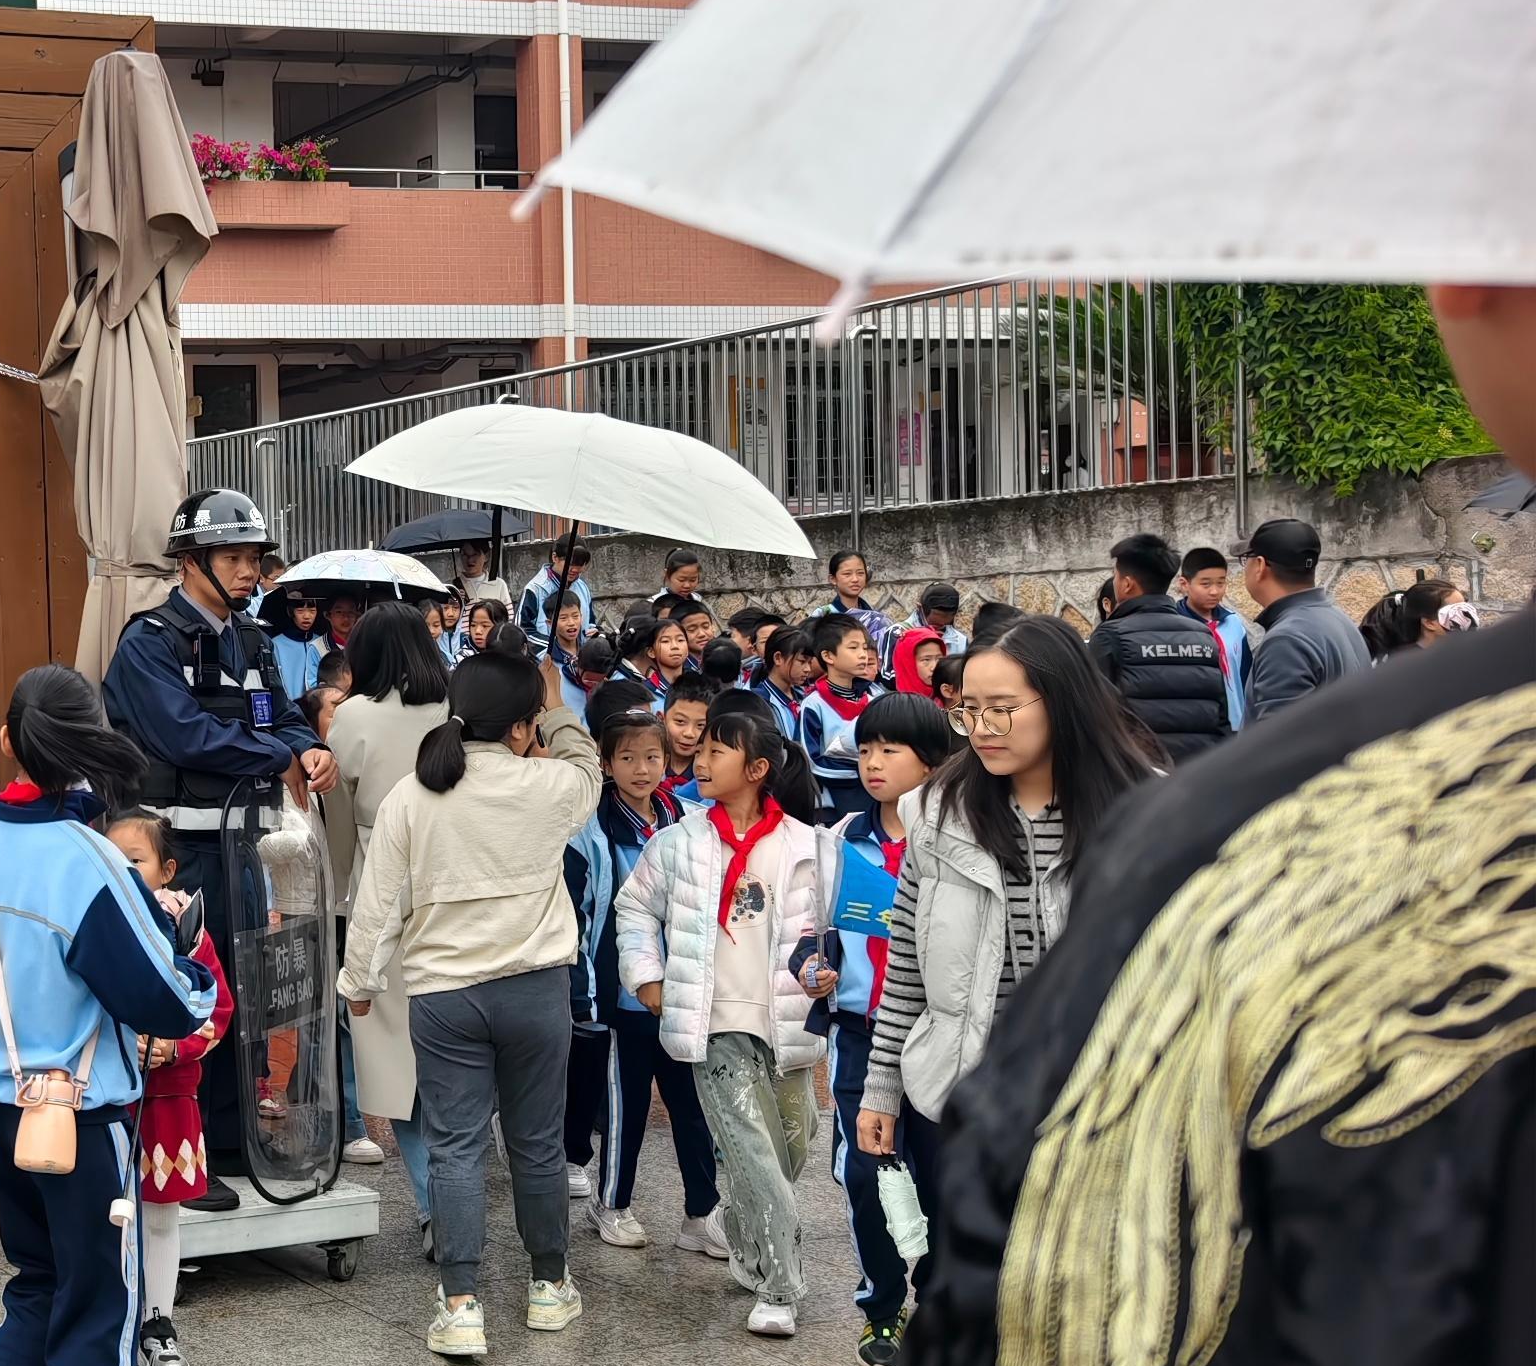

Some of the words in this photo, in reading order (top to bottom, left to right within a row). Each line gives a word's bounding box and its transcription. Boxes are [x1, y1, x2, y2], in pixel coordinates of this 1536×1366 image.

[174, 509, 212, 531] 防暴
[1141, 644, 1203, 658] KELME
[275, 937, 307, 981] 防暴
[270, 983, 295, 1010] FANG
[296, 976, 314, 1003] BAO
